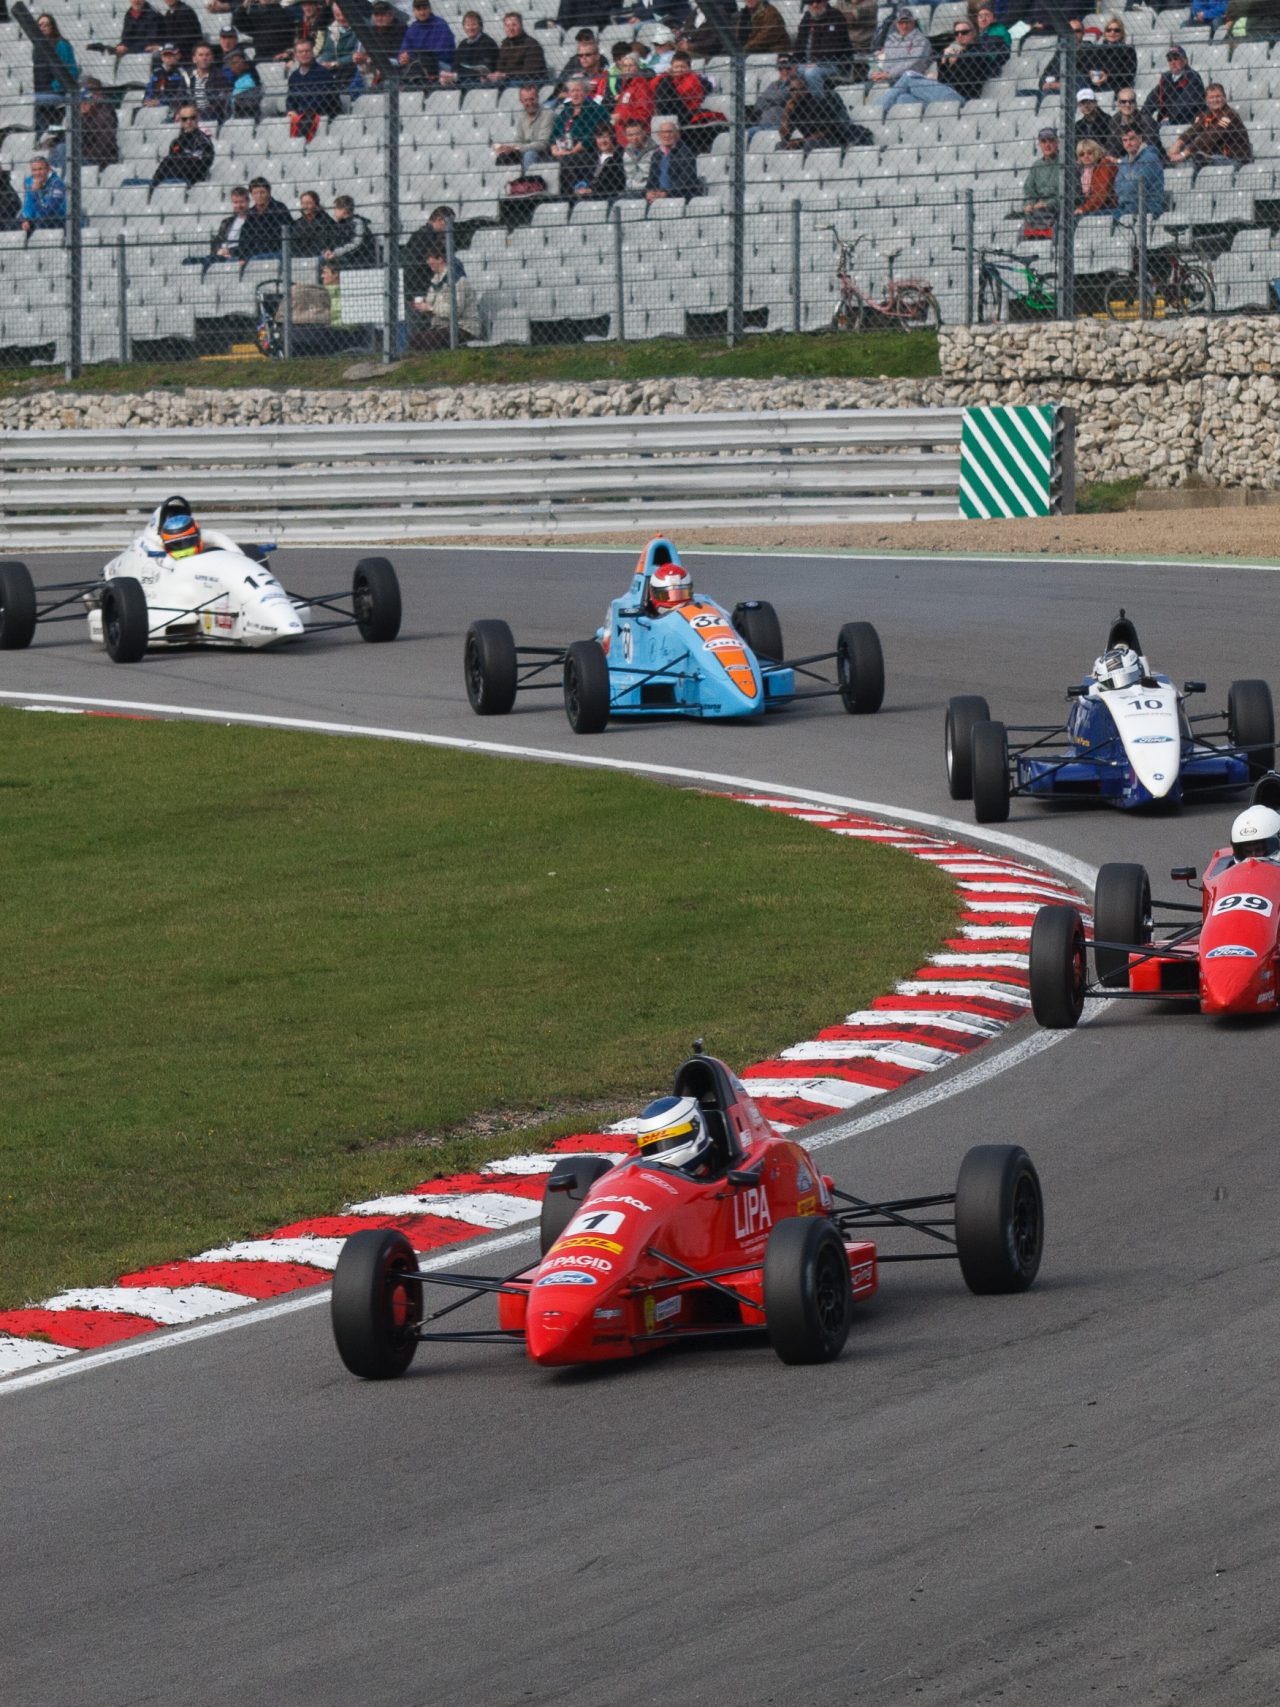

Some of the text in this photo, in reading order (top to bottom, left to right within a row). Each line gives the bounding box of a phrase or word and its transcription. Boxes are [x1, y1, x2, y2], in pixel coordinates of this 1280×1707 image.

[1127, 699, 1163, 711] 10
[1138, 736, 1167, 744] Ford
[1217, 895, 1269, 912] 99
[1214, 946, 1248, 957] Ford
[733, 1184, 773, 1240] LIPA
[583, 1213, 610, 1230] 1
[560, 1238, 611, 1248] DHL
[553, 1255, 613, 1271] PAGID
[543, 1272, 584, 1284] Ford
